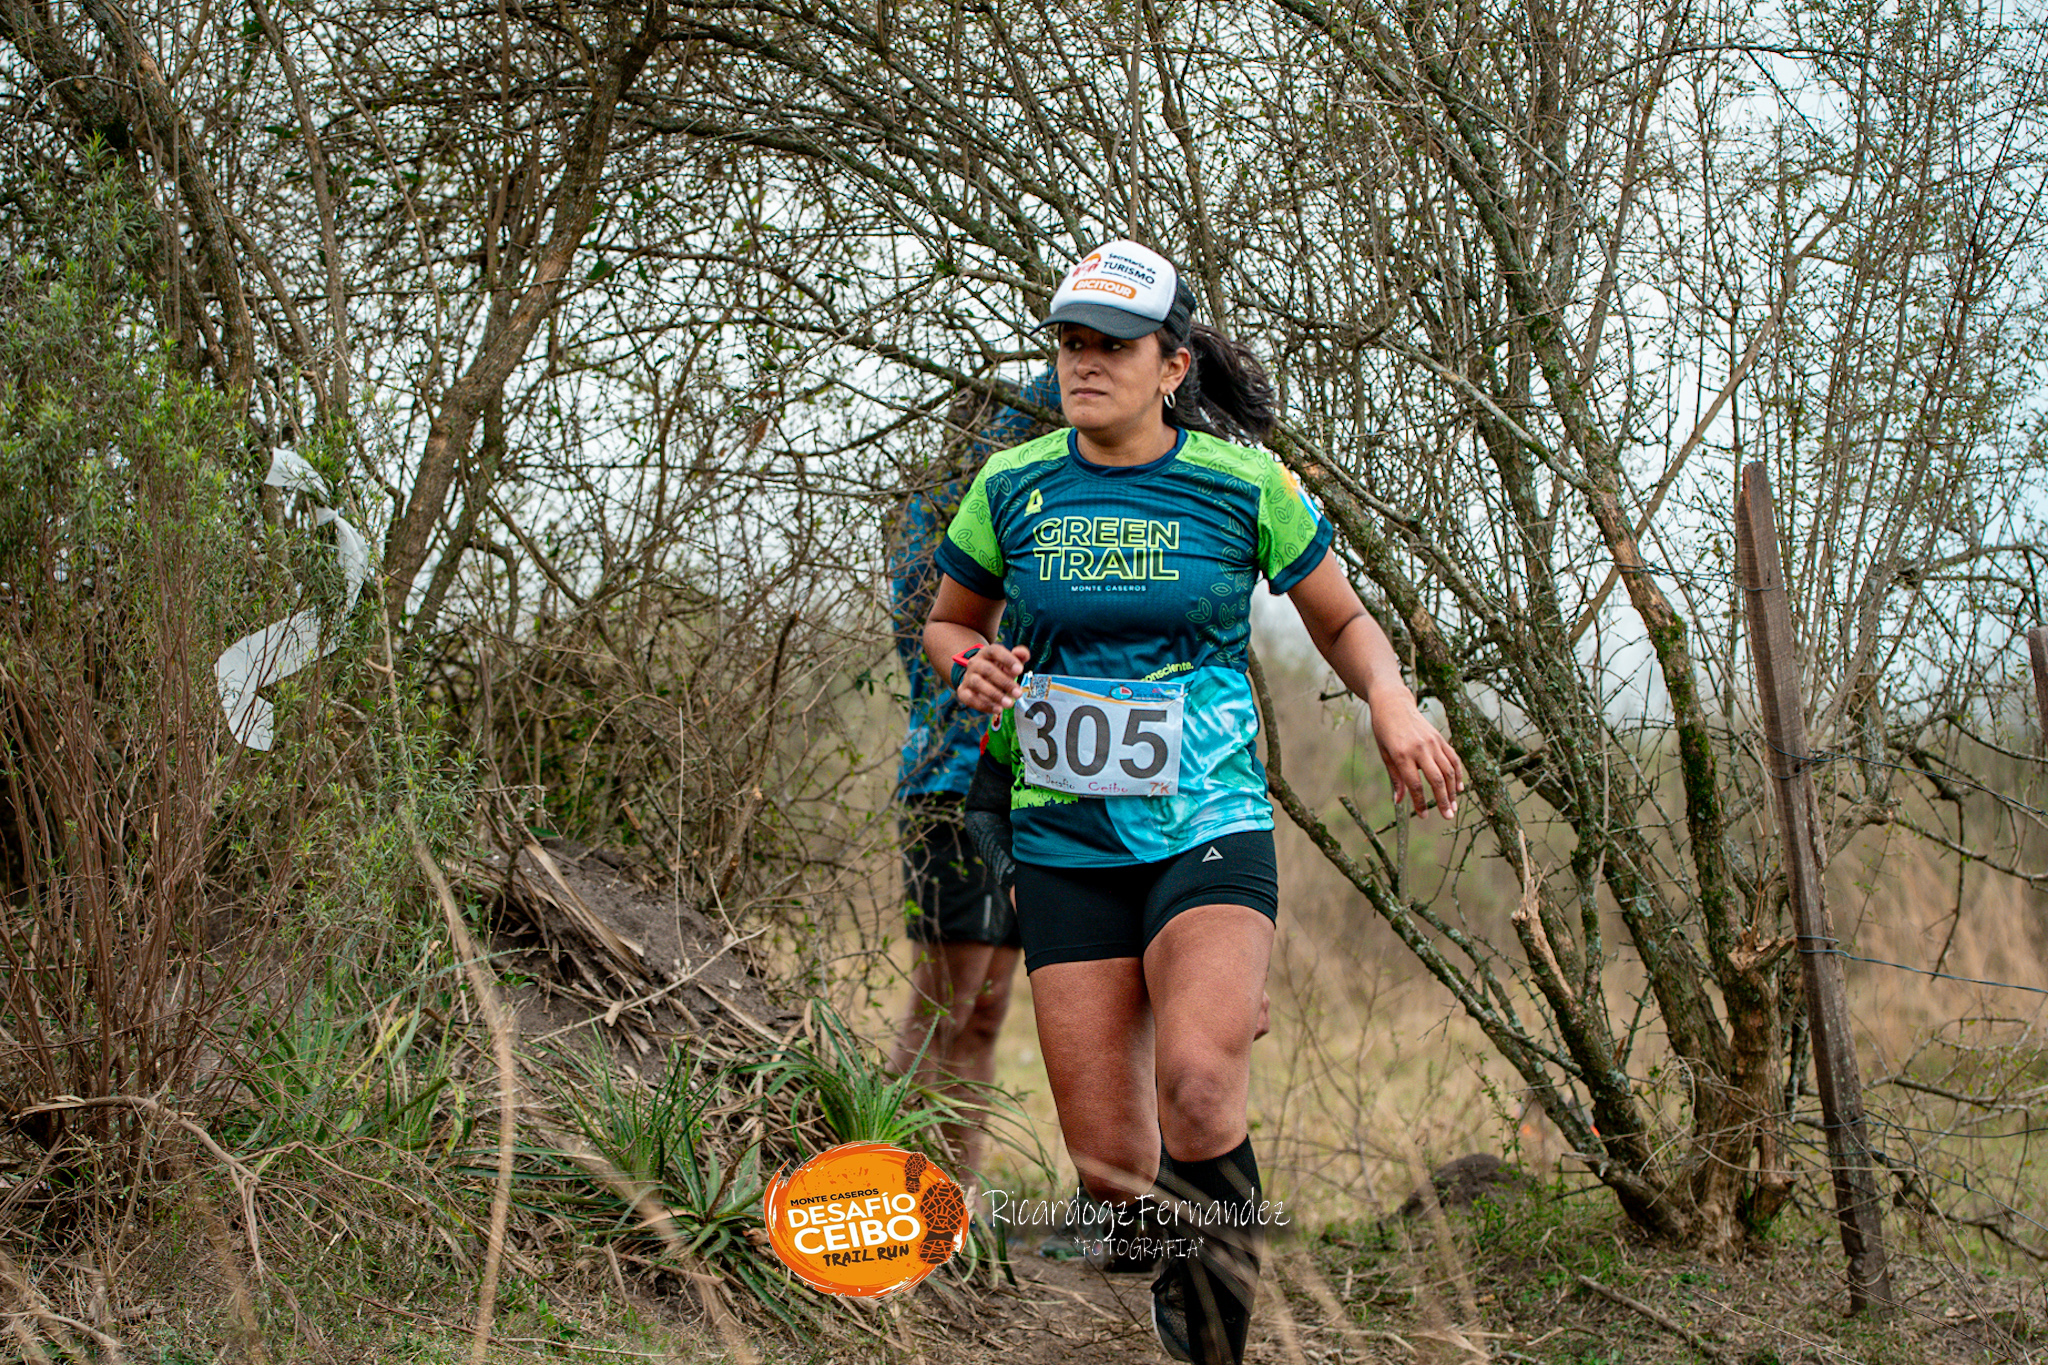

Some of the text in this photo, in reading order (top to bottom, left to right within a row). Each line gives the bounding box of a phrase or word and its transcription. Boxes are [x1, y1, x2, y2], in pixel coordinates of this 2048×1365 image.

[1103, 261, 1155, 285] TURISMO
[1076, 279, 1132, 298] BICITOUR
[1033, 516, 1180, 550] GREEN
[1033, 546, 1180, 581] TRAIL
[1024, 701, 1169, 779] 305
[1088, 781, 1129, 794] Ceibo
